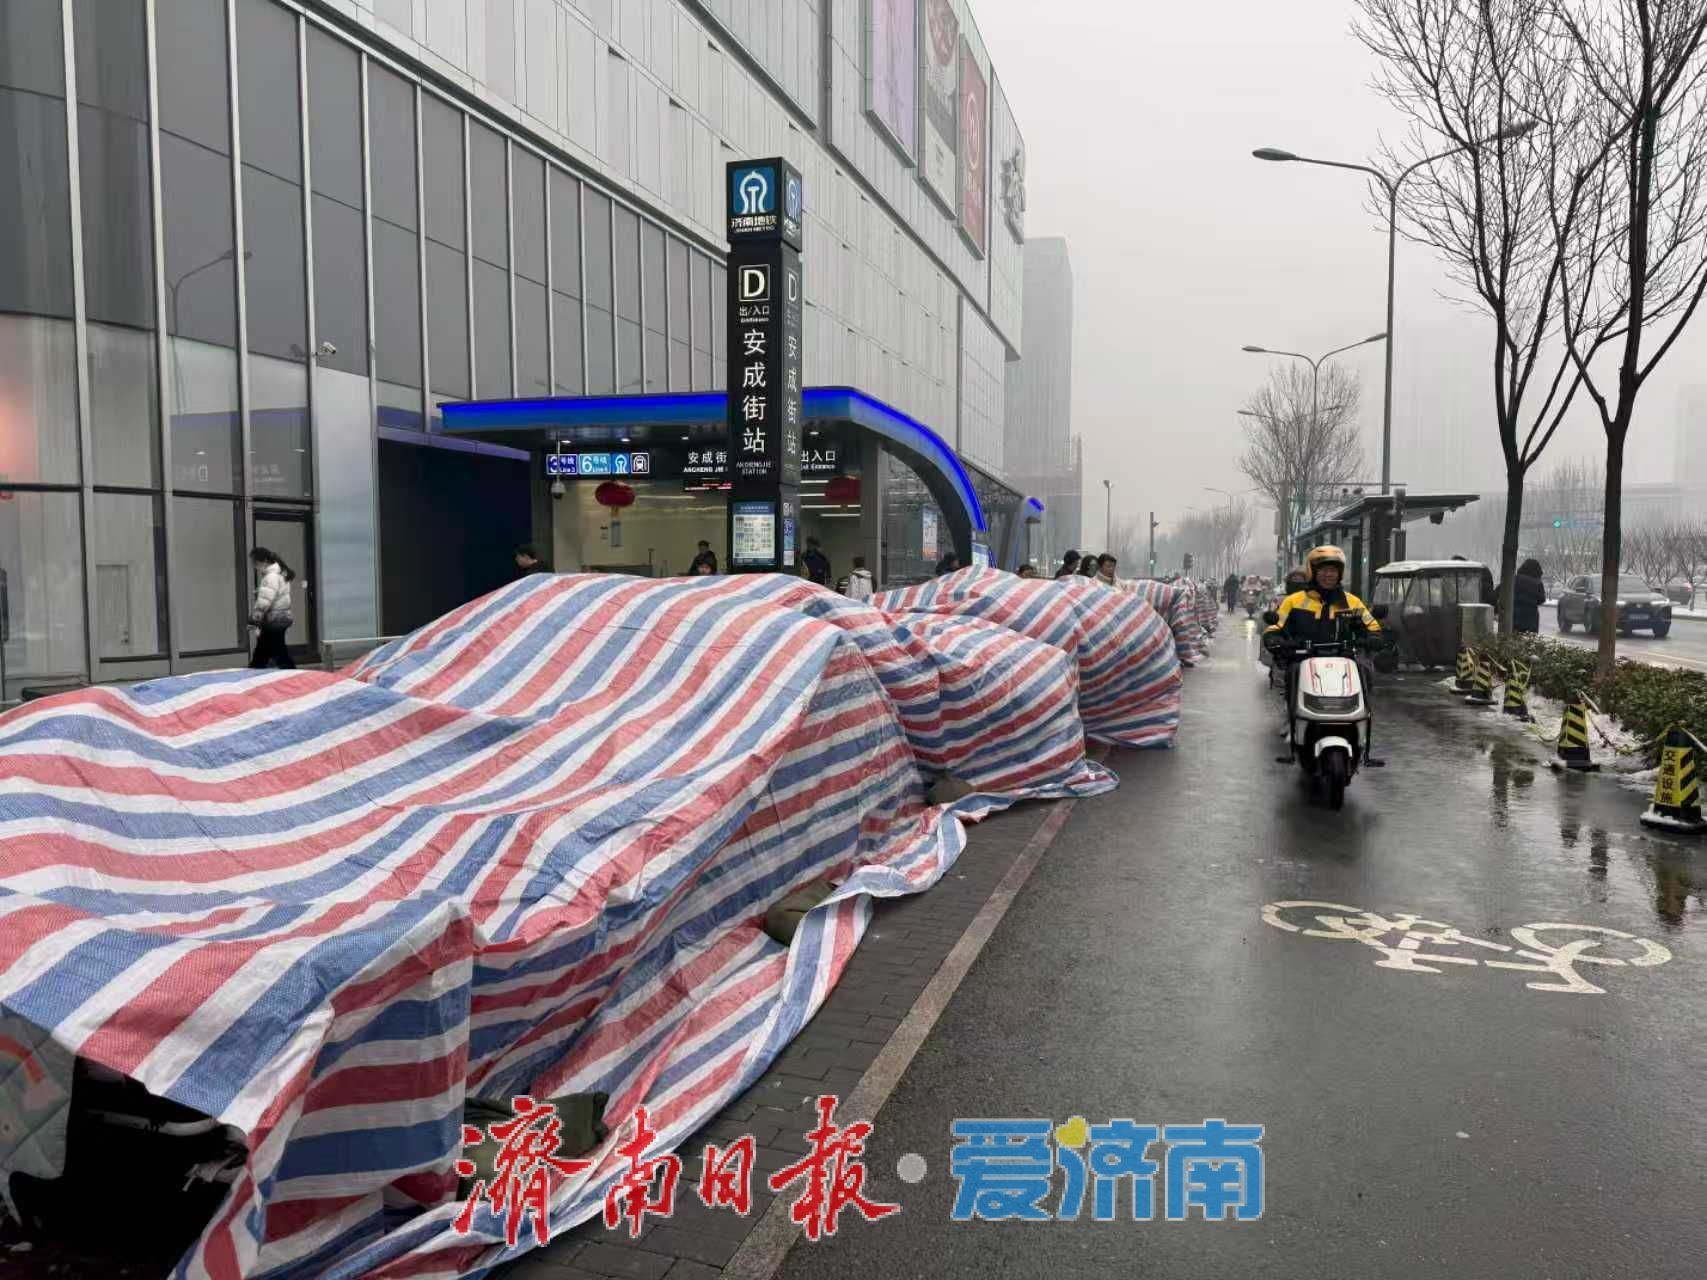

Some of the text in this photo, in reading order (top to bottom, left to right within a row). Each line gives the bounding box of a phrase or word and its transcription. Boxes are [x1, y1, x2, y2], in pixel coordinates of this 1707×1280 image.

[731, 215, 777, 229] 济南地铁
[743, 269, 765, 297] D
[788, 272, 797, 302] D
[739, 305, 770, 317] 出/入口
[742, 328, 767, 453] 安成街站
[1661, 750, 1676, 804] 交通设施
